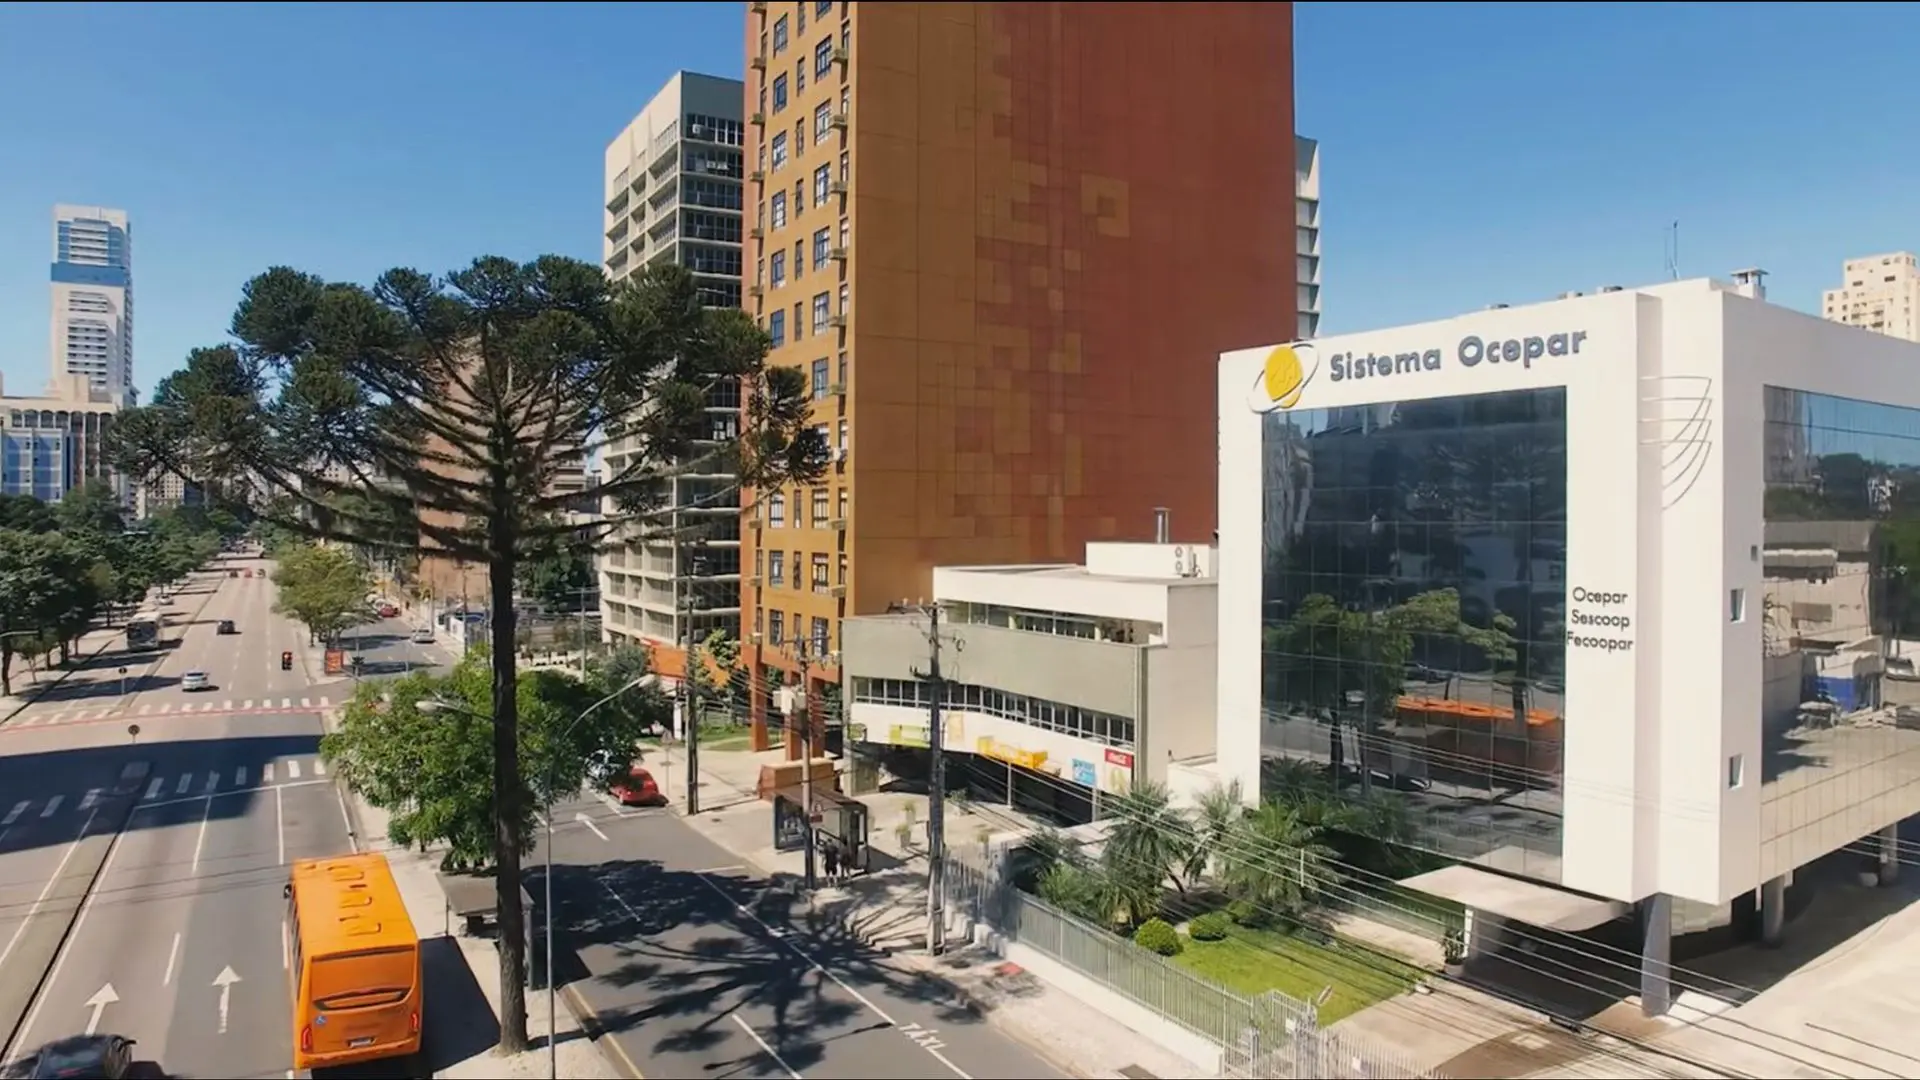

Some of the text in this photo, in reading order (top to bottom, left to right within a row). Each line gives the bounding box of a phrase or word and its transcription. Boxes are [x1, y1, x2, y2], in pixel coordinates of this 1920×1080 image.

[1330, 329, 1588, 382] Sistema Ocepar
[1573, 586, 1628, 607] Ocepar
[1571, 609, 1630, 631] Sescoop
[1567, 631, 1633, 653] Fecoopar
